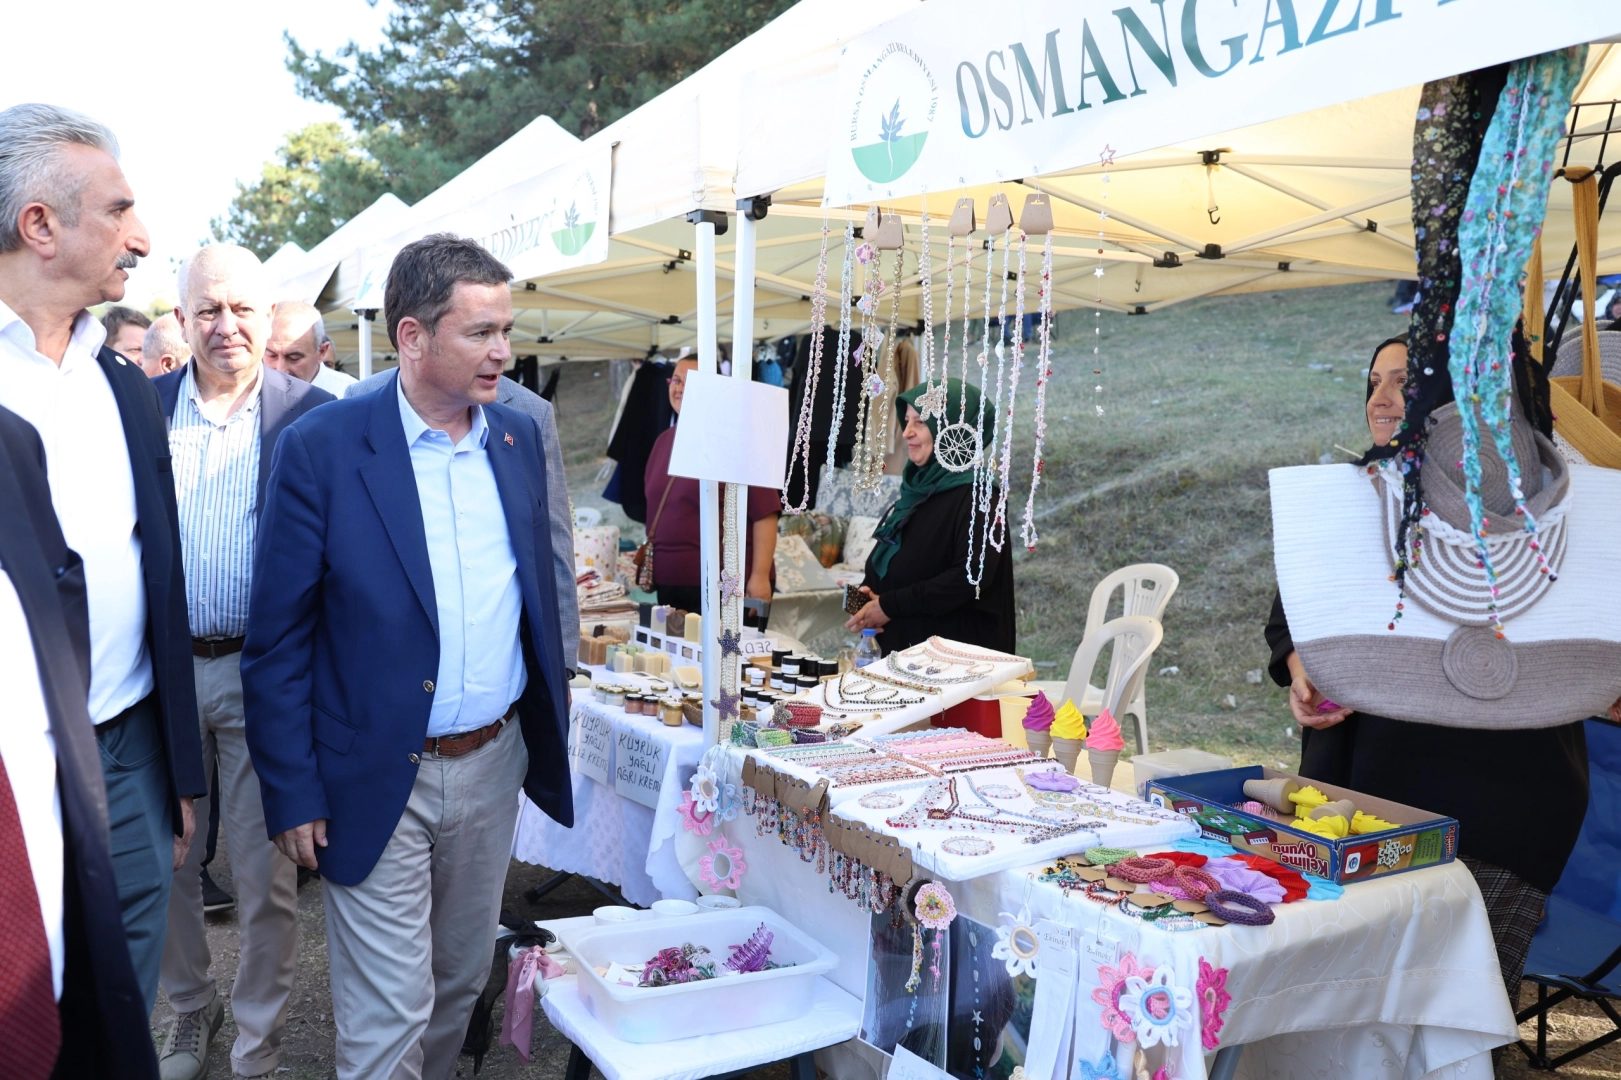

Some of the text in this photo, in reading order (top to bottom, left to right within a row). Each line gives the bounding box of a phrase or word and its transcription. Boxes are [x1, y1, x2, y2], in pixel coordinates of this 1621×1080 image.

[850, 100, 862, 141] BURSA
[927, 96, 938, 122] 1987
[572, 711, 612, 740] KUYRUK
[618, 733, 661, 762] KUYRUK
[617, 766, 637, 784] AĞRI
[628, 755, 655, 775] YAĞLI
[1271, 841, 1317, 859] Oyunu
[1281, 854, 1329, 879] Kelime
